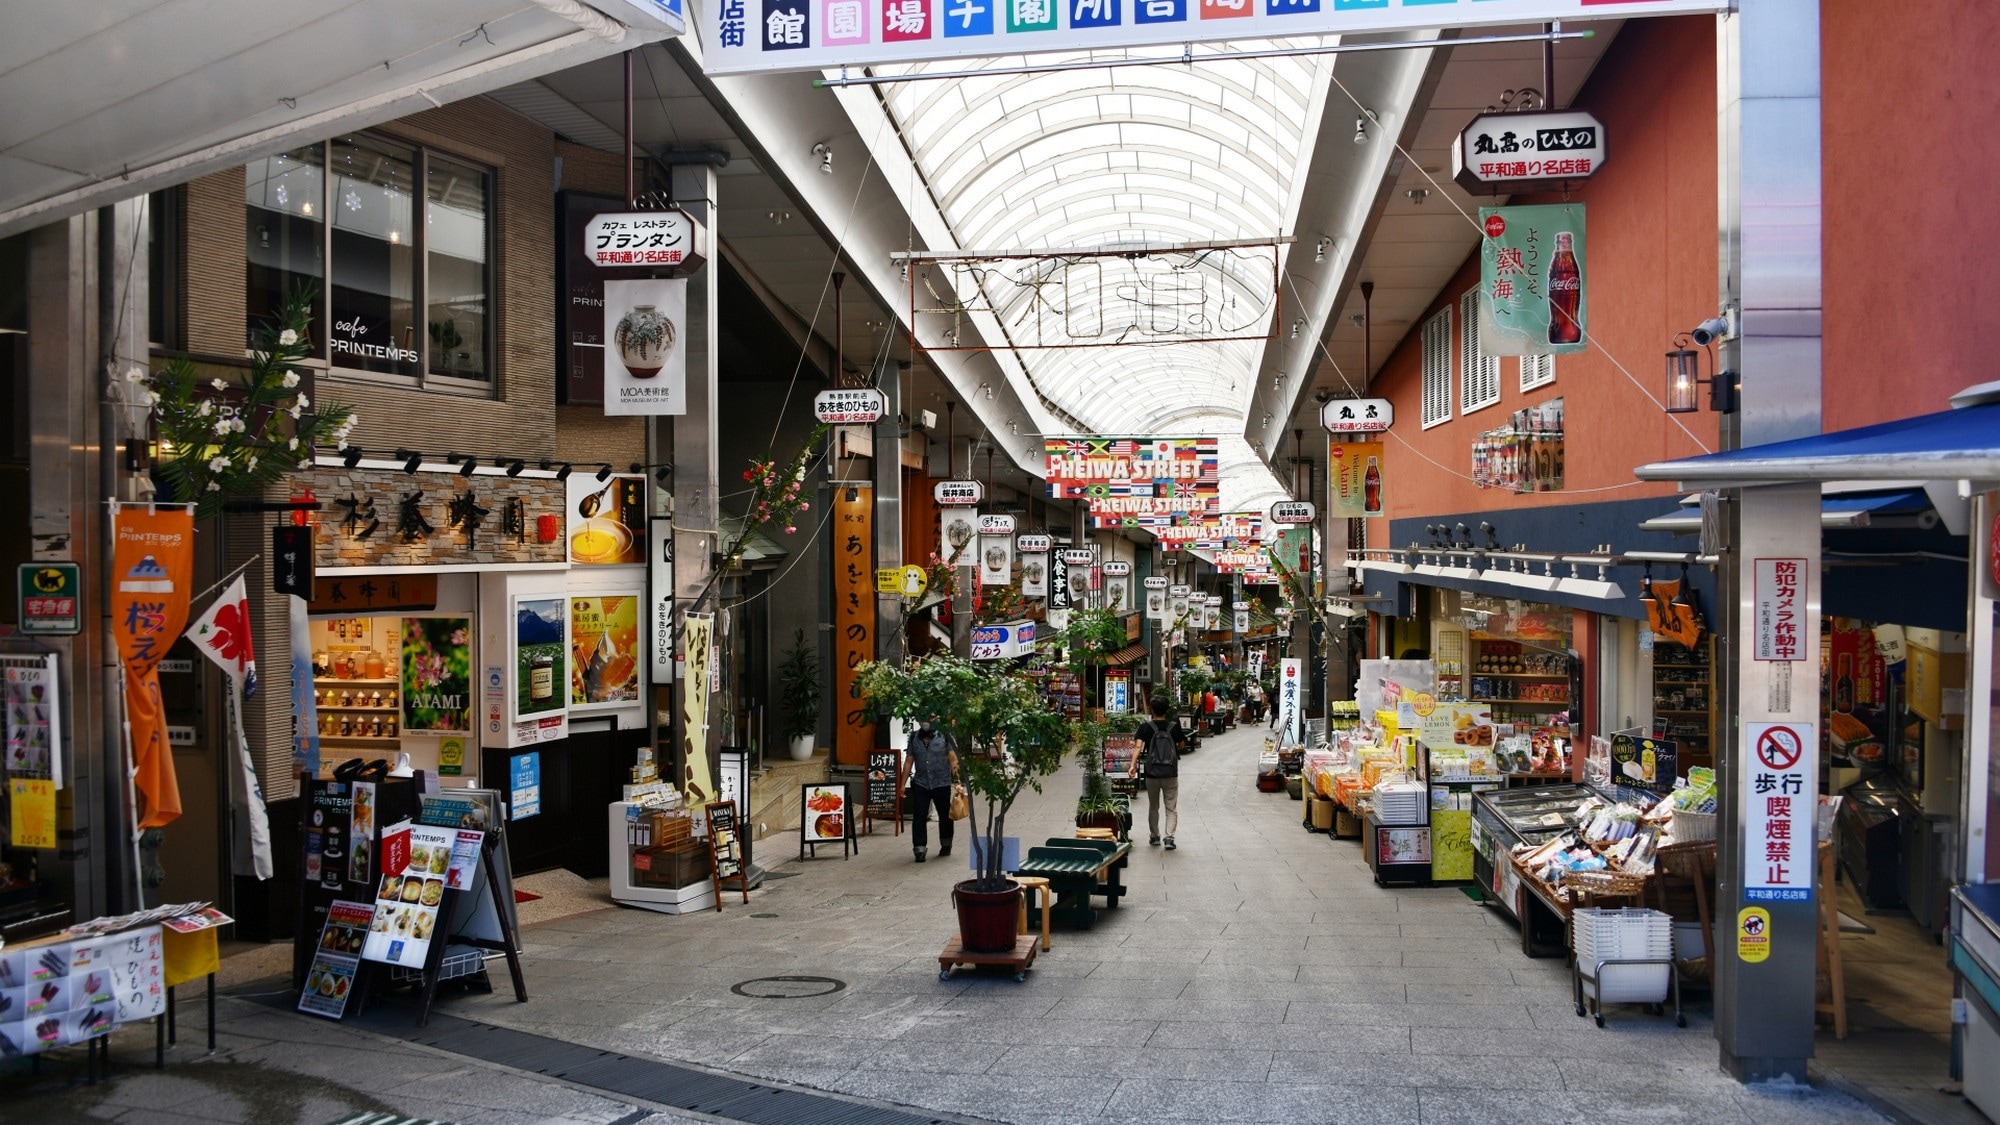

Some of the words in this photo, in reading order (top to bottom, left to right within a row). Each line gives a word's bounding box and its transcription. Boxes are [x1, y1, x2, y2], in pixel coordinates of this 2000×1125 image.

[1479, 159, 1592, 178] 平和通り名店街
[602, 221, 627, 230] カフェ
[633, 220, 677, 229] レストラン
[596, 230, 682, 249] プランタン
[596, 250, 682, 264] 平和通り名店街
[573, 297, 605, 307] PRIN
[336, 316, 368, 335] cafe
[330, 338, 418, 363] PRINTEMPS
[620, 387, 669, 397] MOA美術館
[818, 401, 879, 413] あをきのひもの
[821, 413, 876, 422] 平和通り名店街
[1331, 422, 1386, 430] 平和通り名店街
[1061, 459, 1130, 479] HEIWA
[1131, 459, 1203, 479] STREET
[1341, 463, 1351, 498] Atami
[942, 489, 975, 497] 桜井商店
[1353, 486, 1359, 494] to
[1101, 498, 1153, 513] HEIWA
[1154, 498, 1207, 512] STREET
[1166, 526, 1208, 538] HEIWA
[1208, 525, 1253, 537] STREET
[1221, 554, 1256, 565] HEIWA
[1052, 548, 1067, 606] お食事処
[28, 599, 72, 615] 宅急便
[1774, 562, 1797, 659] 防犯カメラ作動中
[1761, 602, 1770, 657] 平和通り名店街
[411, 694, 462, 709] ATAMI
[870, 754, 896, 767] しらす丼
[1755, 772, 1804, 795] 歩行
[1765, 797, 1791, 884] 喫煙禁止
[1747, 889, 1808, 900] 平和通り名店街
